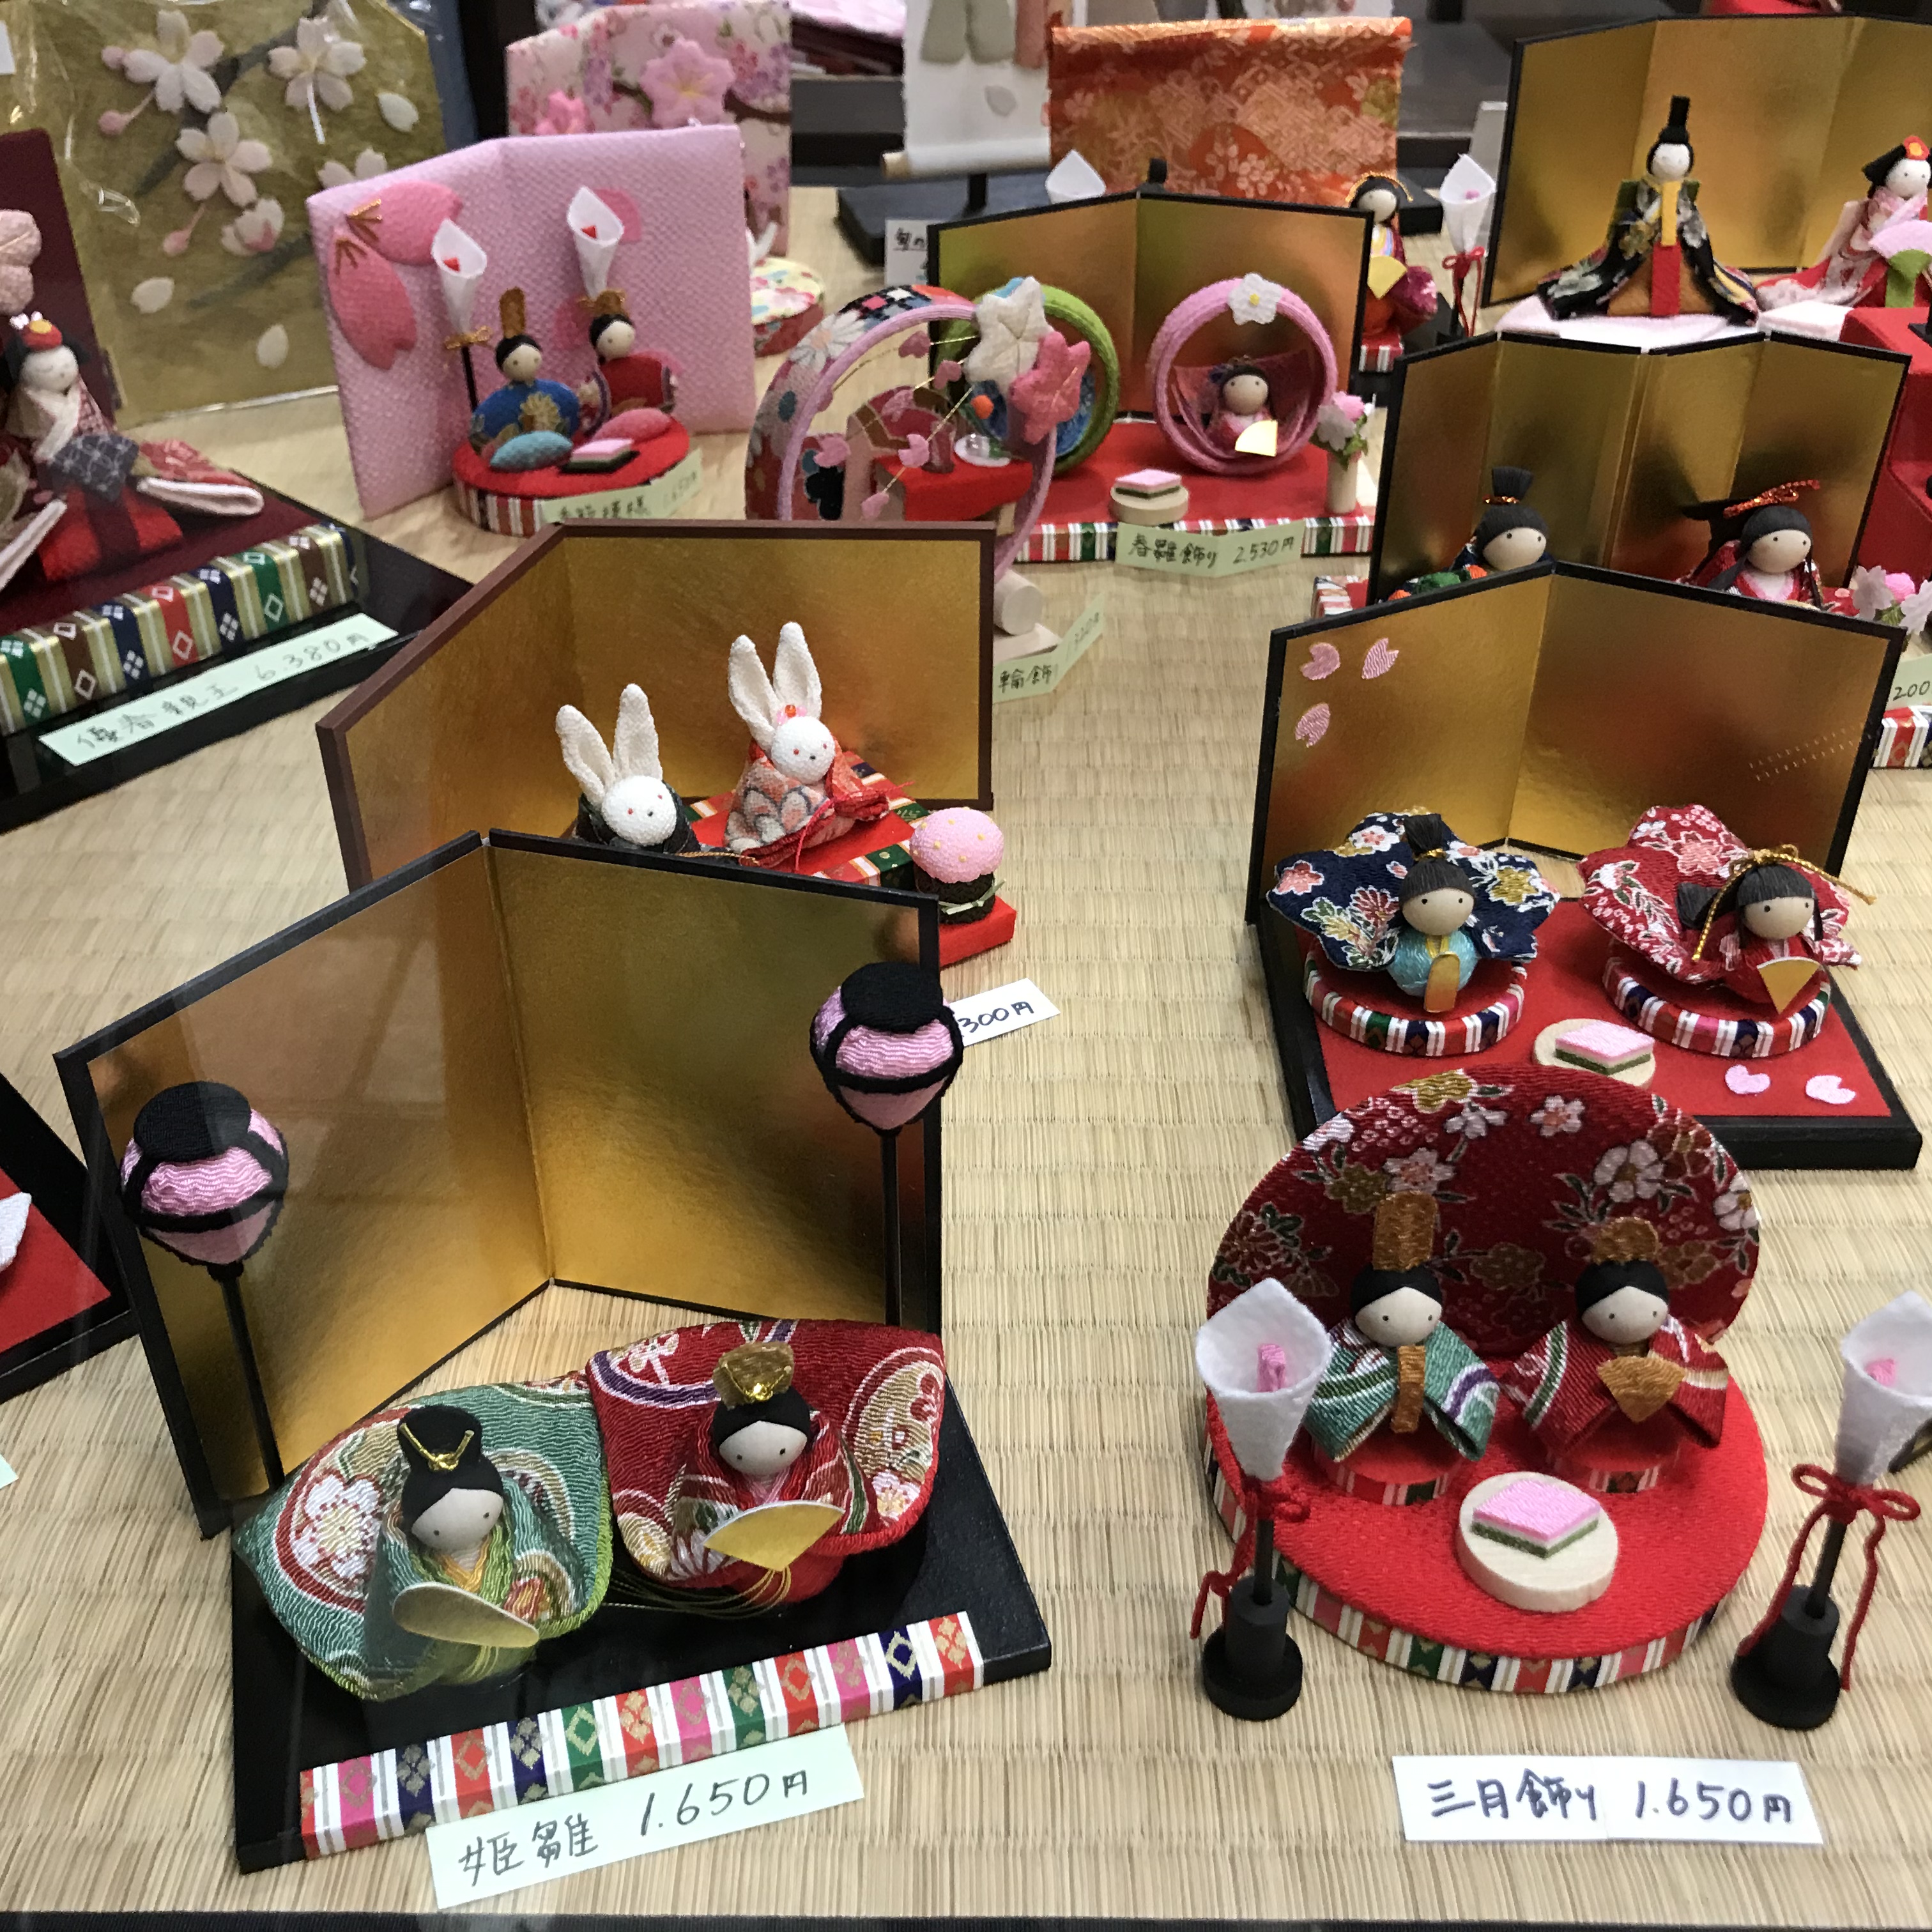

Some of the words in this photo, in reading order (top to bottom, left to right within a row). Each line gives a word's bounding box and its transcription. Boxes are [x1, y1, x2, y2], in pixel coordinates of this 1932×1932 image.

[640, 1769, 808, 1837] 1.650円
[1427, 1768, 1597, 1821] 三月飾り
[1636, 1777, 1792, 1824] 1.650円
